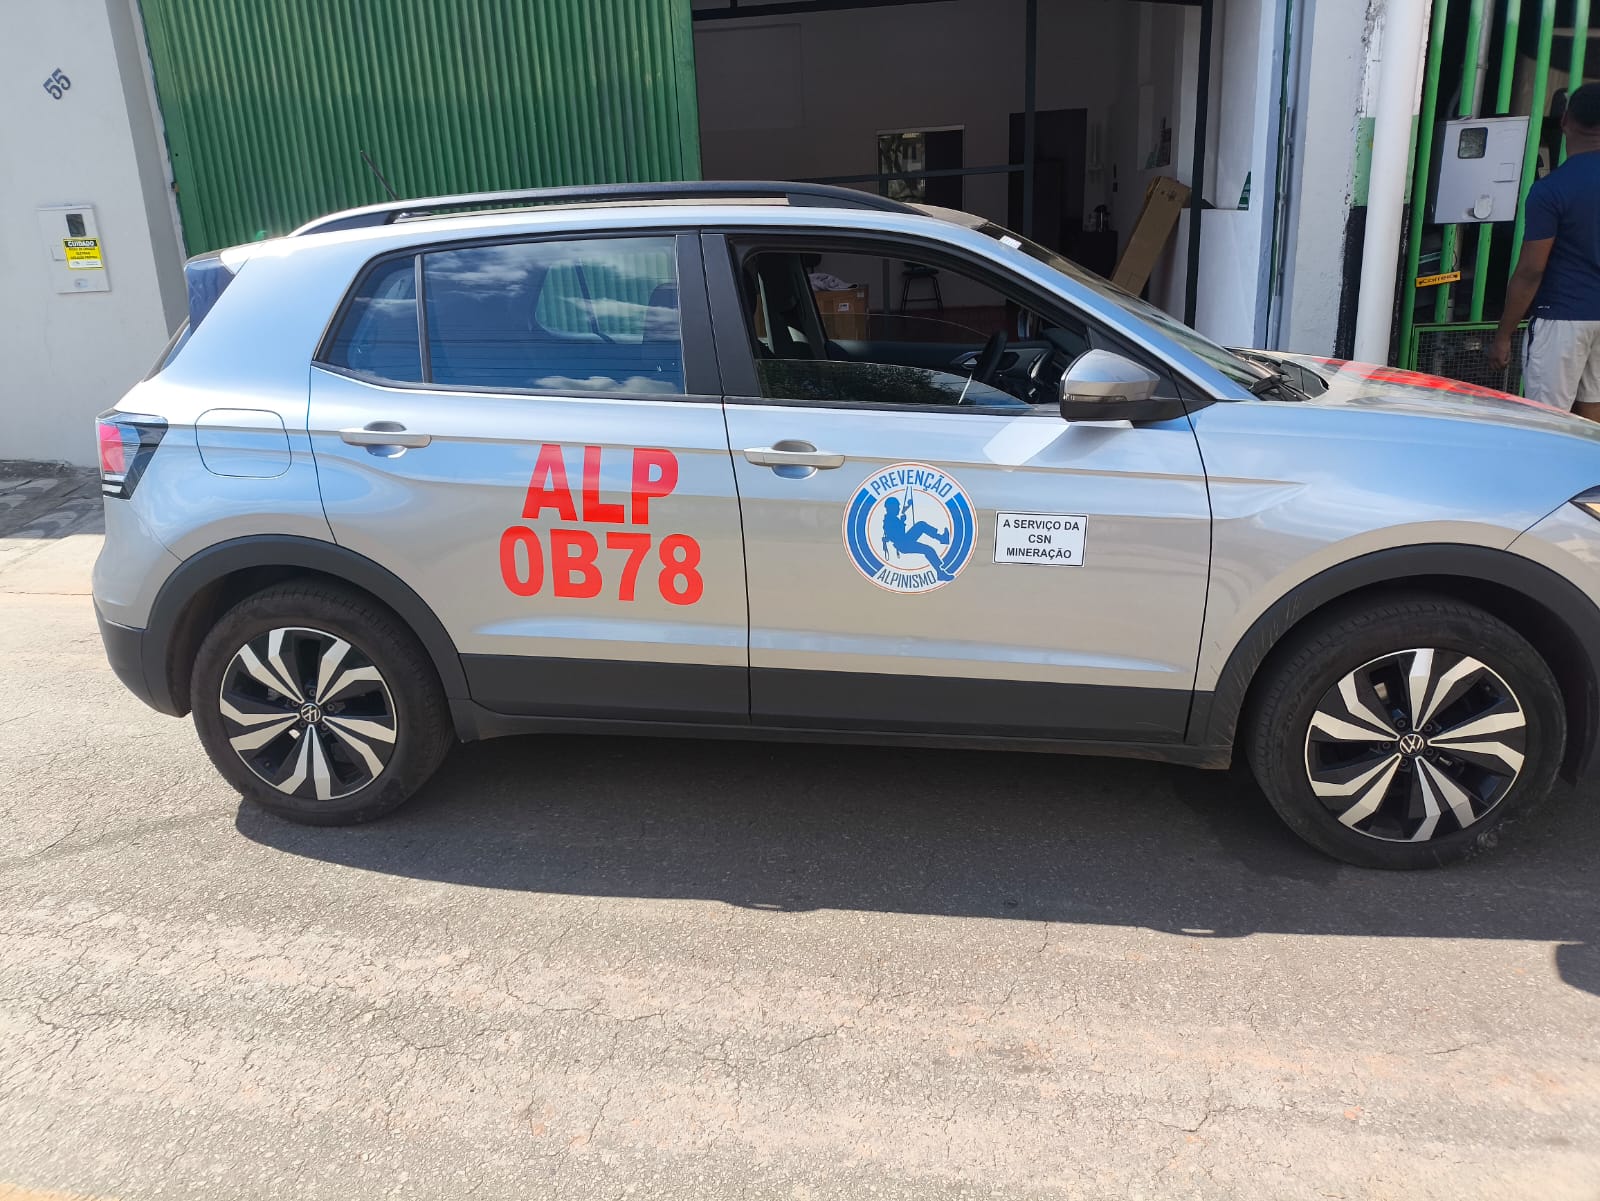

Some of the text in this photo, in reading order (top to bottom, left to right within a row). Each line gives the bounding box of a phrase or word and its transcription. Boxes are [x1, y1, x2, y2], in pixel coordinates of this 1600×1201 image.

[43, 68, 71, 100] 55
[521, 443, 679, 525] ALP
[870, 469, 953, 498] PREVENÇÃO
[1003, 519, 1080, 532] A SERVIÇO DA
[1028, 534, 1052, 544] CSN
[499, 525, 704, 606] 0B78
[1006, 547, 1072, 560] MINERAÇÃO
[877, 568, 937, 589] ALPINISMO
